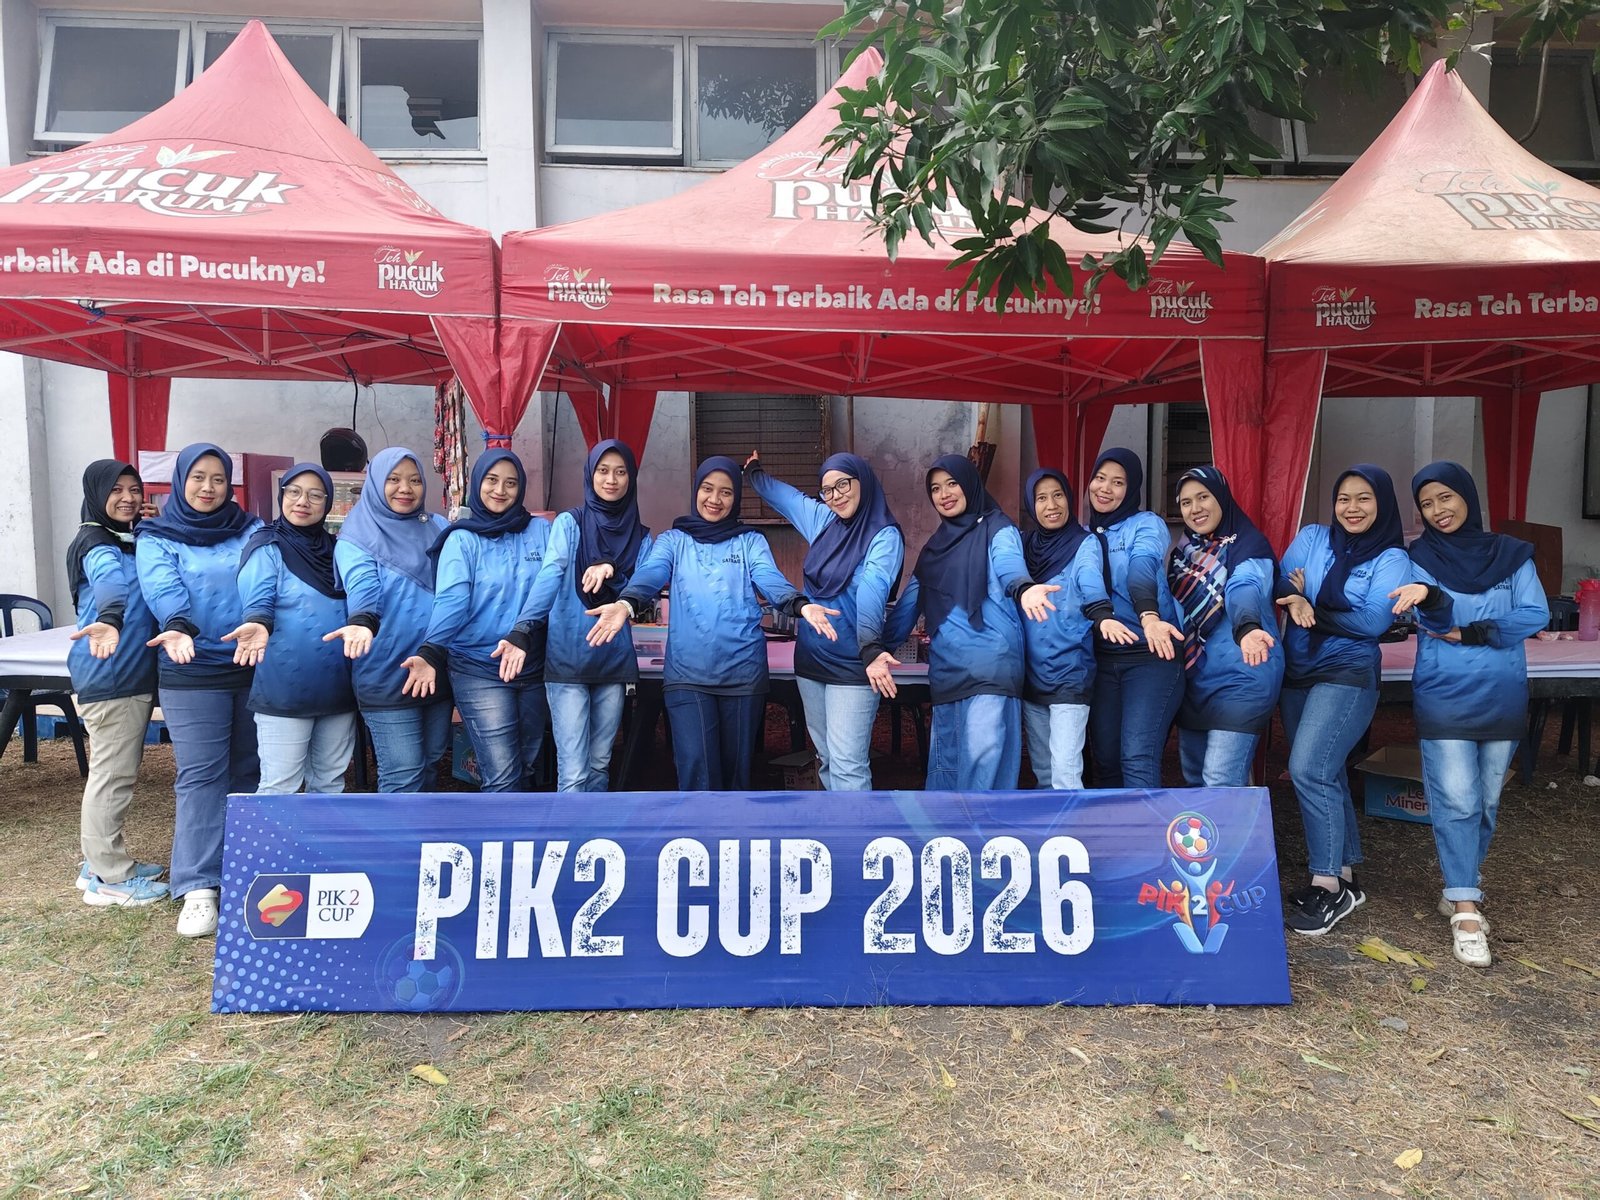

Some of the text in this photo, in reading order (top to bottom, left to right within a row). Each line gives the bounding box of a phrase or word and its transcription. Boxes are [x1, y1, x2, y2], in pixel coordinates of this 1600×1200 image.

[2, 167, 300, 205] pucuk
[46, 189, 257, 215] HARUM
[1435, 191, 1600, 230] puc
[373, 247, 401, 264] Teh
[85, 251, 141, 276] Ada
[147, 252, 174, 277] di
[180, 254, 326, 289] Pucuknya!
[378, 260, 445, 289] pucuk
[543, 266, 570, 282] Teh
[389, 280, 441, 295] HARUM
[547, 277, 614, 301] pucuk
[653, 283, 714, 305] Rasa
[719, 284, 766, 307] Teh
[772, 284, 872, 310] Terbaik
[876, 287, 928, 311] Ada
[935, 288, 960, 312] di
[1147, 277, 1173, 295] Teh
[1311, 286, 1337, 303] Teh
[558, 294, 608, 307] HARUM
[1149, 291, 1214, 318] pucuk
[1315, 295, 1377, 327] pucuk
[1414, 298, 1472, 319] Rasa
[1478, 292, 1522, 316] Teh
[1160, 308, 1208, 321] HARUM
[1325, 315, 1372, 328] HARUM
[1407, 784, 1424, 800] Le
[316, 888, 360, 906] PIK 2
[413, 835, 1095, 960] PIK2 CUP 2026
[1137, 883, 1267, 917] PIK 2 CUP
[318, 907, 355, 922] CUP
